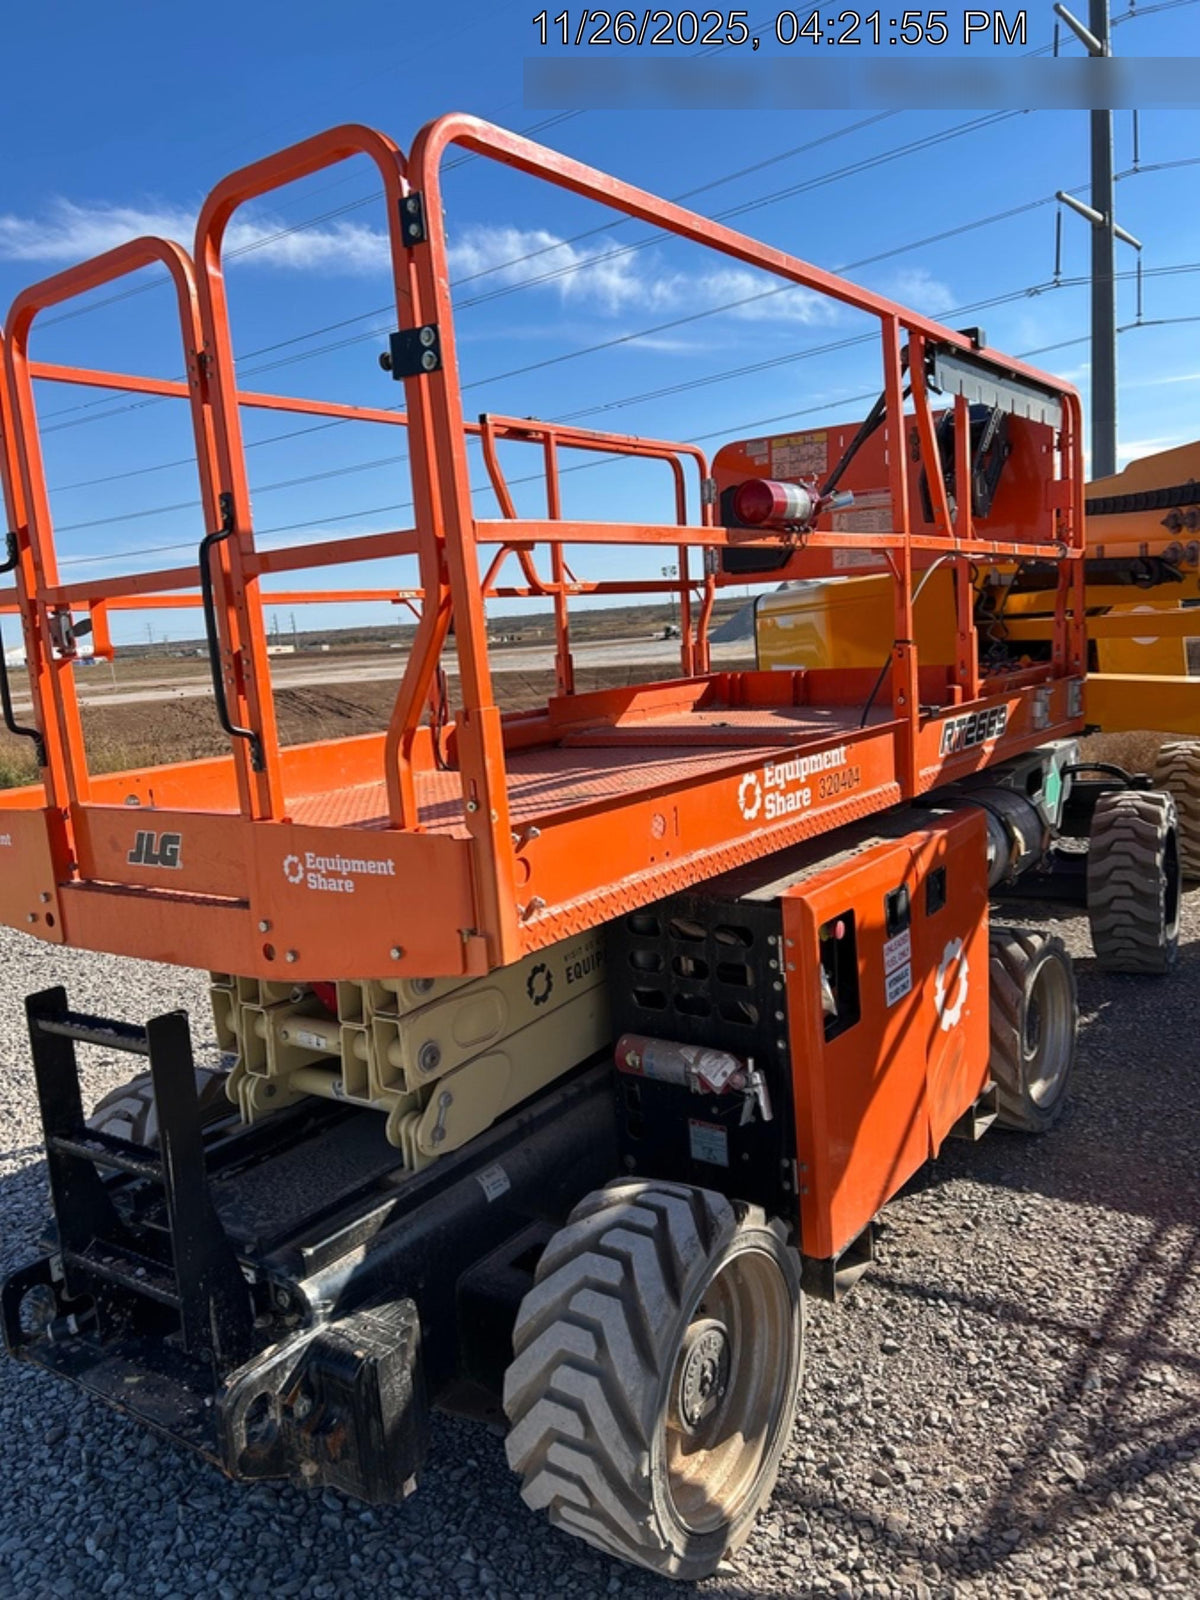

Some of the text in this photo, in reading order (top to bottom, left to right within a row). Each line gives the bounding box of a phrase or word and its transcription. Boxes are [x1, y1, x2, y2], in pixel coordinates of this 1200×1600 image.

[763, 744, 847, 790] Equipment
[818, 767, 861, 800] 320404
[765, 786, 812, 821] Share
[127, 830, 182, 868] JLG
[303, 852, 395, 877] Equipment
[306, 871, 355, 894] Share
[566, 951, 605, 983] EQUIP
